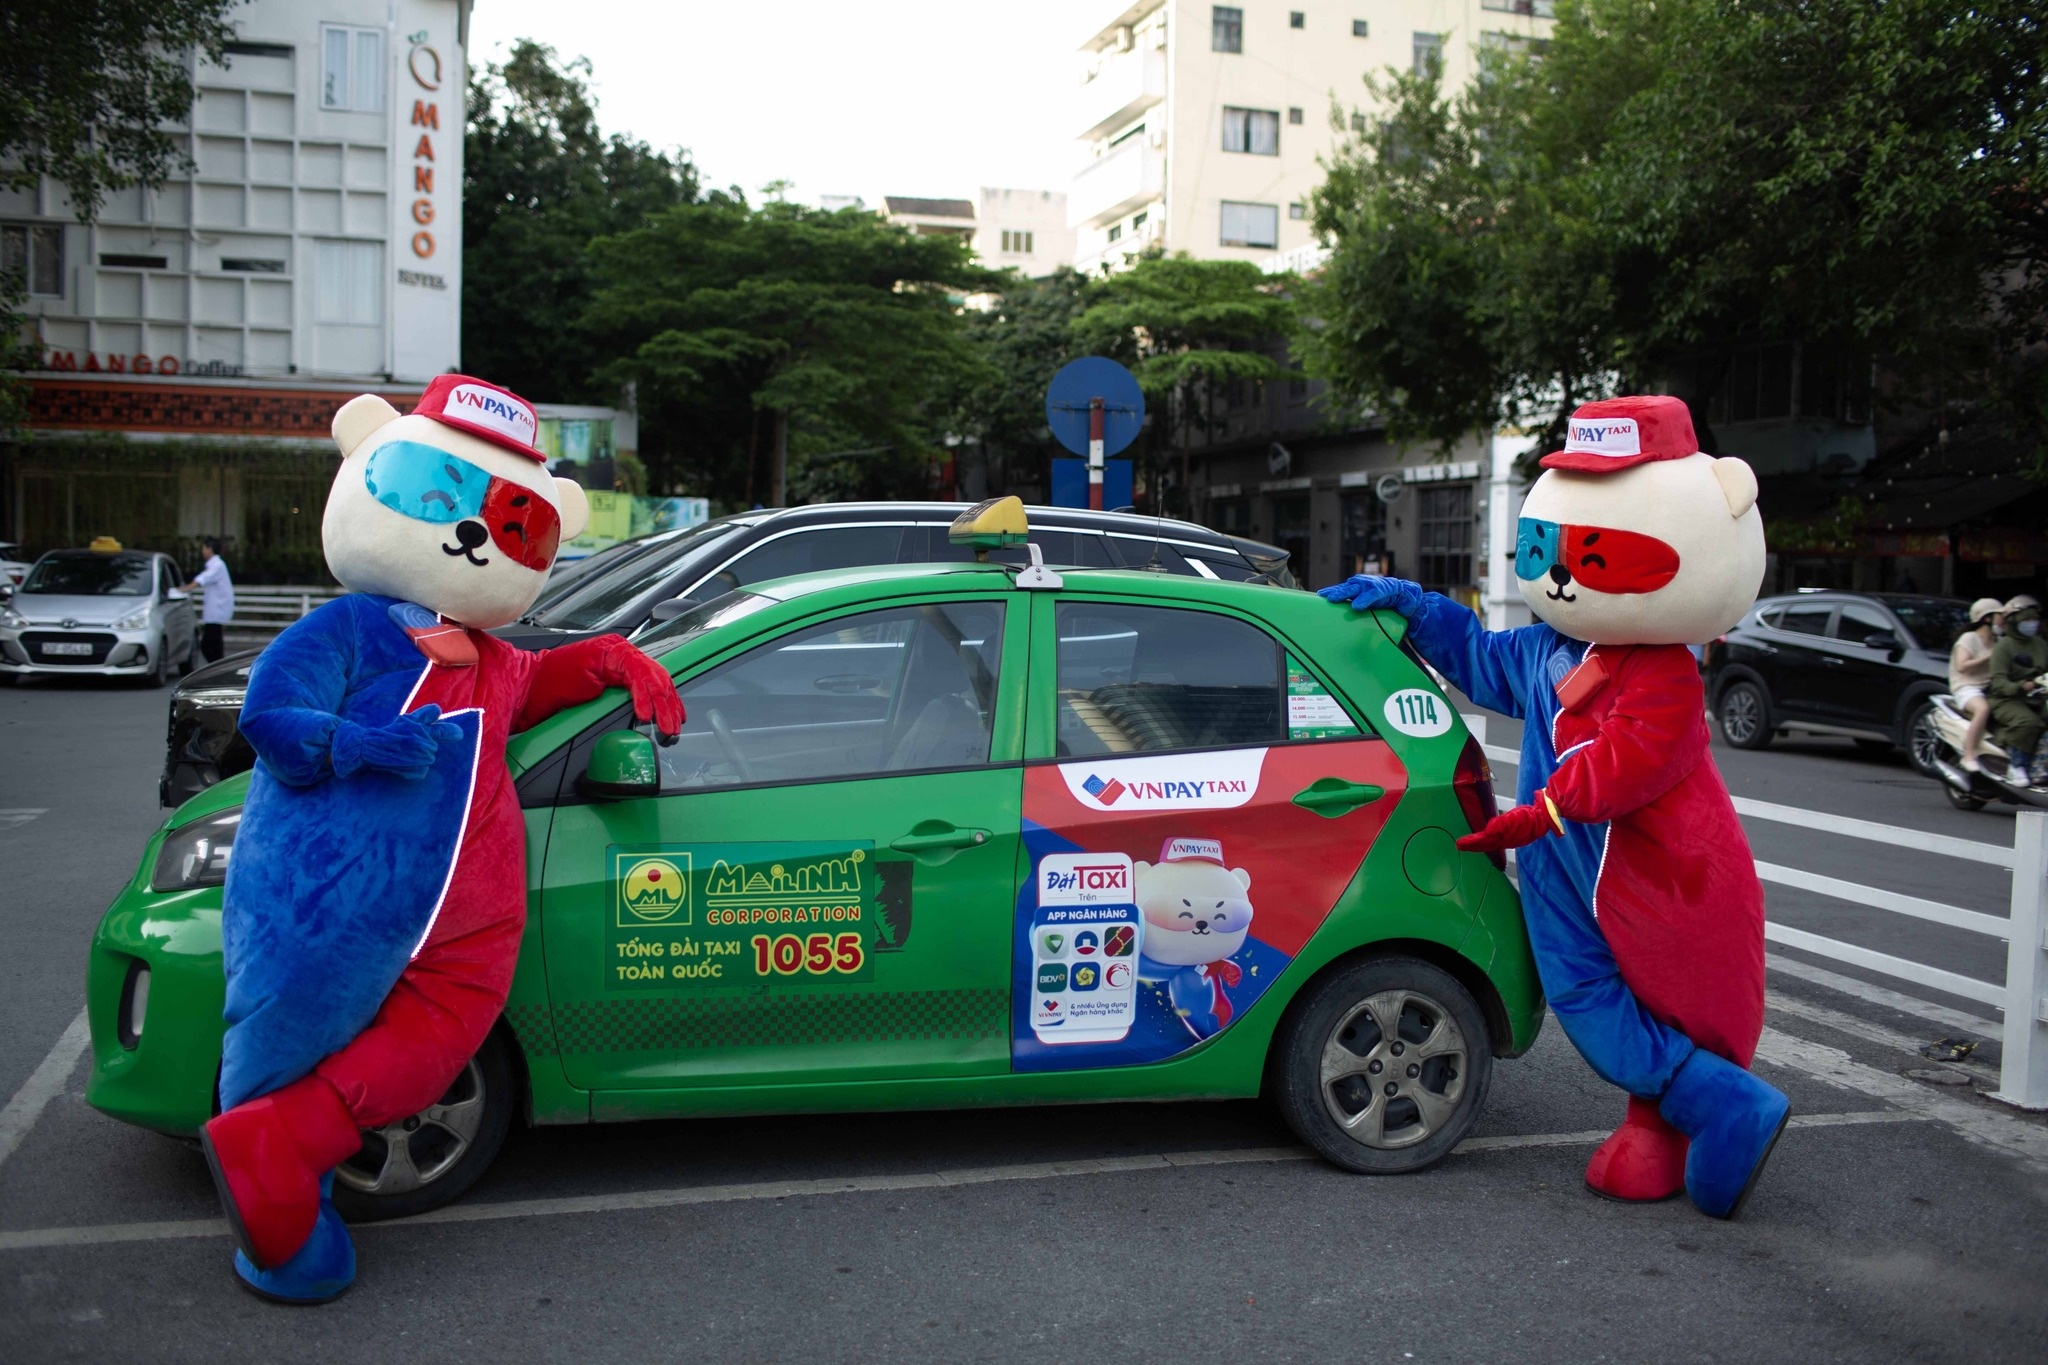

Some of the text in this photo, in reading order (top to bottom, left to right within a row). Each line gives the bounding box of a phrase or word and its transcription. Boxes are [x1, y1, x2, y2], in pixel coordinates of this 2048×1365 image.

[412, 99, 439, 258] MANGO
[50, 351, 180, 375] MANGO
[1395, 693, 1438, 726] 1174
[1047, 871, 1077, 892] Đặt
[1078, 893, 1097, 902] Trên
[707, 905, 861, 926] CORPORATION
[1047, 908, 1128, 921] APP NGÂN HÀNG
[670, 936, 699, 956] ĐÀI
[704, 941, 741, 956] TAXI
[751, 931, 865, 976] 1055
[616, 957, 723, 980] TOÀN QUỐC
[1040, 974, 1059, 984] BIDV
